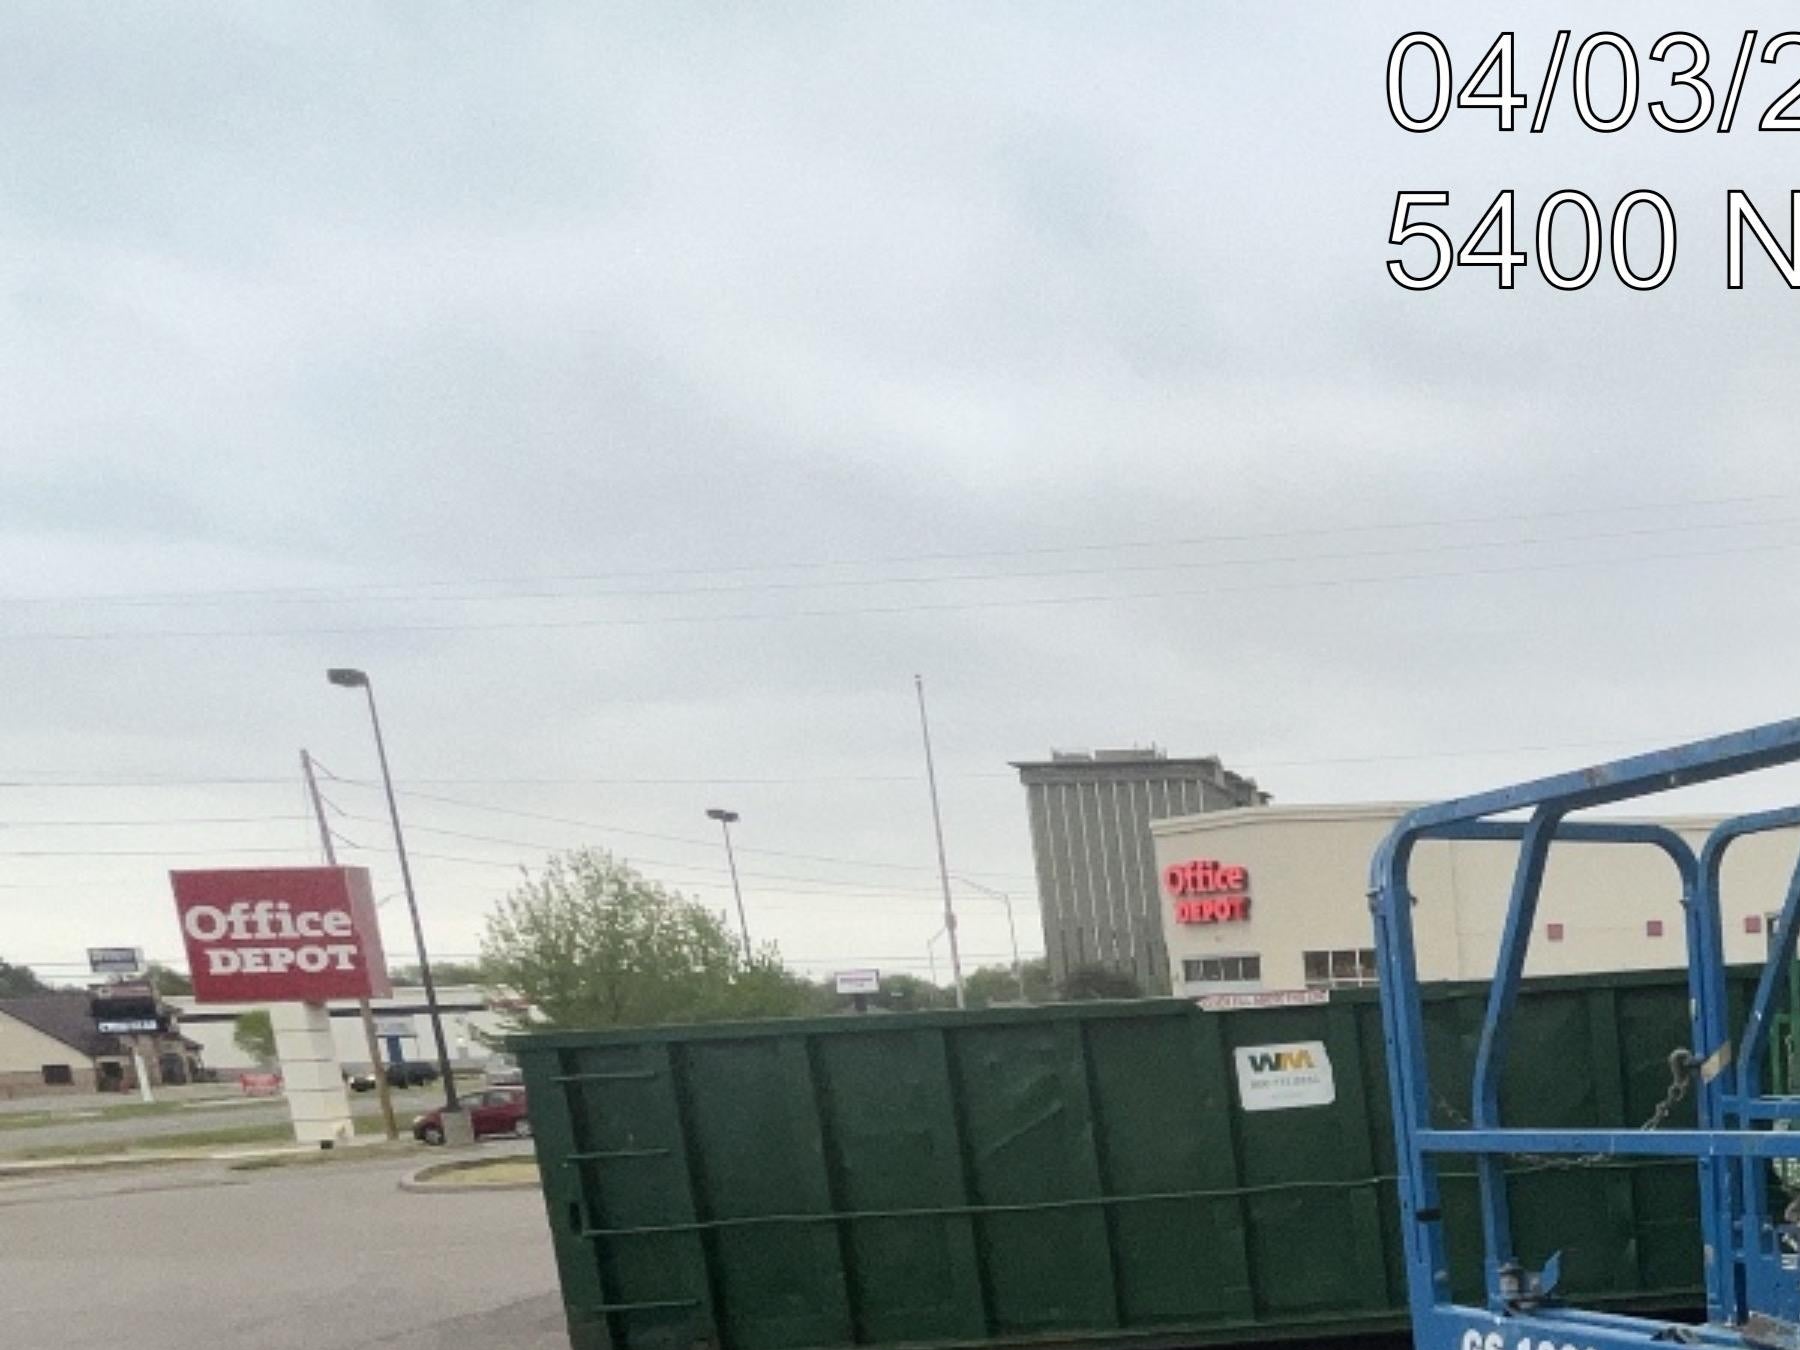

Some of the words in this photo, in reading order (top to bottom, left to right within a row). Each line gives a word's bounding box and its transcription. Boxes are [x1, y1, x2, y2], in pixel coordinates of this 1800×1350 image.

[1164, 861, 1246, 894] Office
[184, 899, 353, 942] Office
[1176, 897, 1248, 923] DEPOT
[206, 945, 358, 974] DEPOT
